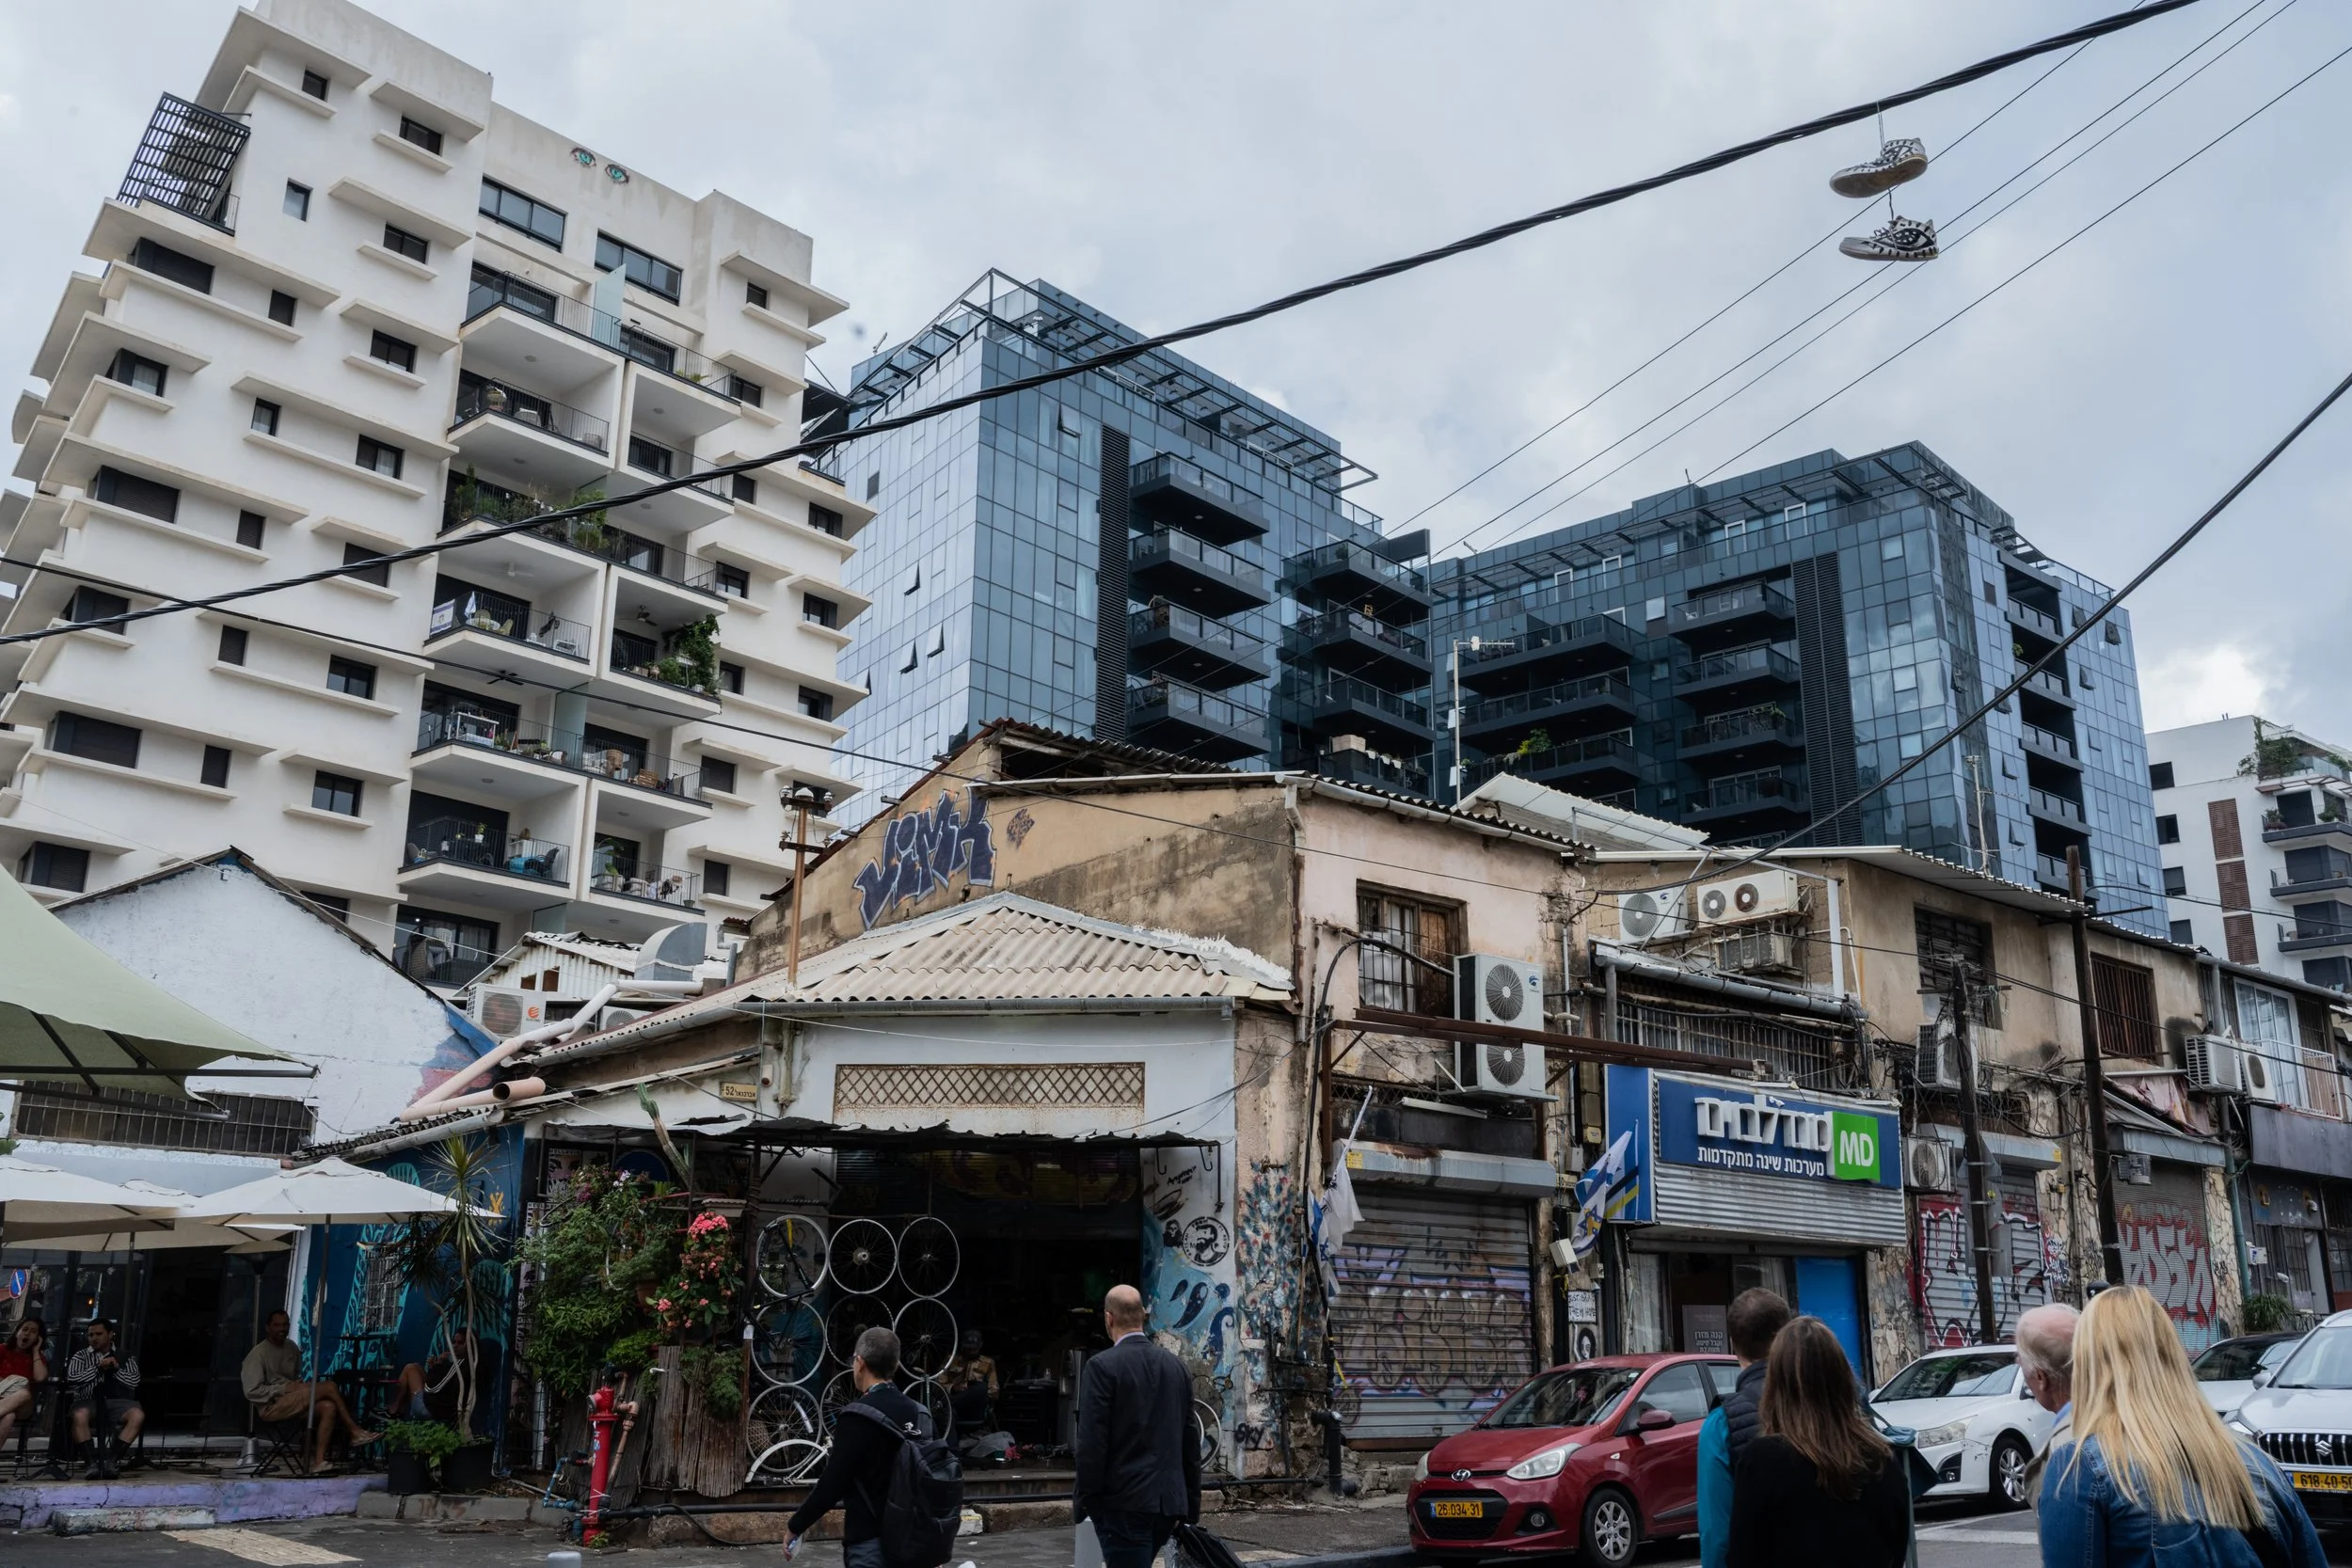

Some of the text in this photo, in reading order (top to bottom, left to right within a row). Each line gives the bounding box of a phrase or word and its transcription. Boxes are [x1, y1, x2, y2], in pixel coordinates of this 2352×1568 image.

[725, 1086, 735, 1096] 52
[1698, 1147, 1824, 1177] מערכות שינה מתקדמות
[1839, 1130, 1874, 1167] MD
